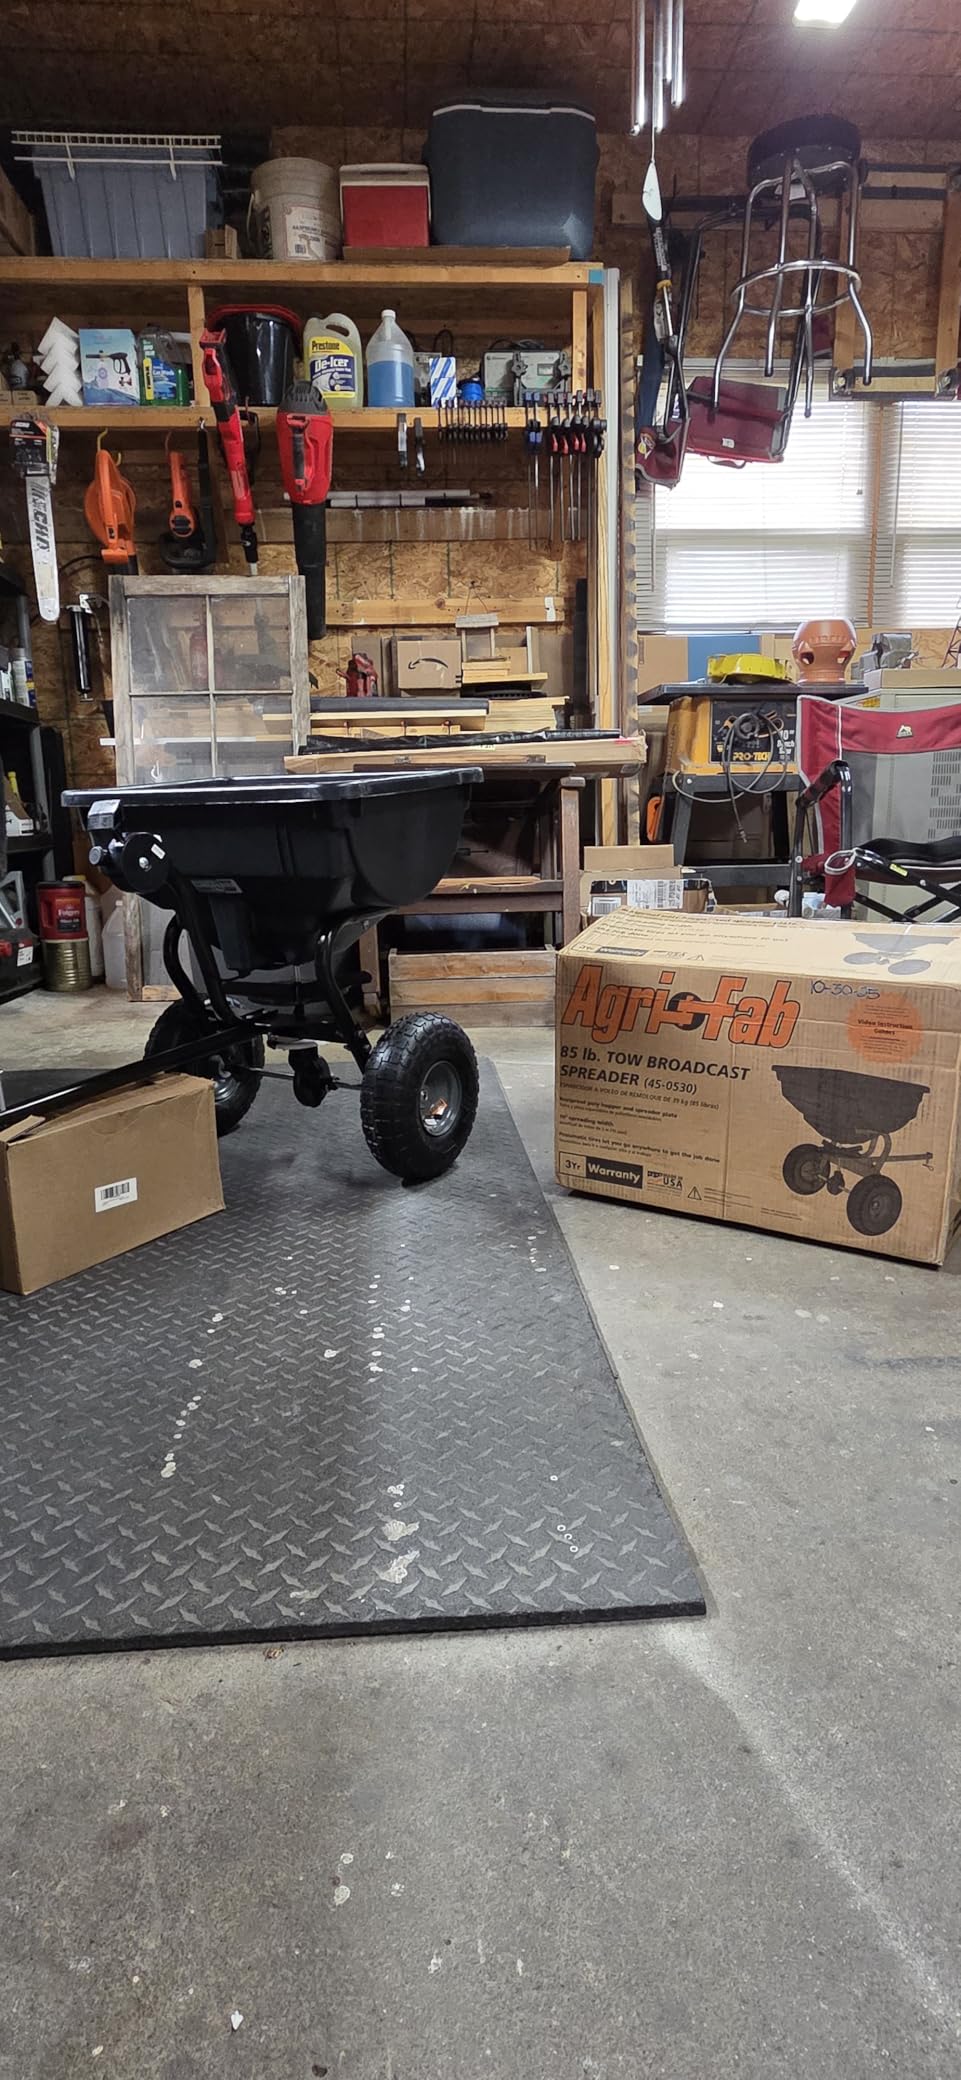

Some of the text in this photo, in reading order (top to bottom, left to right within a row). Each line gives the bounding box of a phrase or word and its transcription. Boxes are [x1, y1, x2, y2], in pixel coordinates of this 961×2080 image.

[312, 340, 340, 351] Prestone
[314, 356, 349, 373] De-Icer
[560, 1045, 751, 1081] 85 lb. TOW BROADCAST
[559, 1064, 697, 1096] SPREADER (45-0530)
[587, 1162, 641, 1184] Warranty
[662, 1176, 683, 1189] USA
